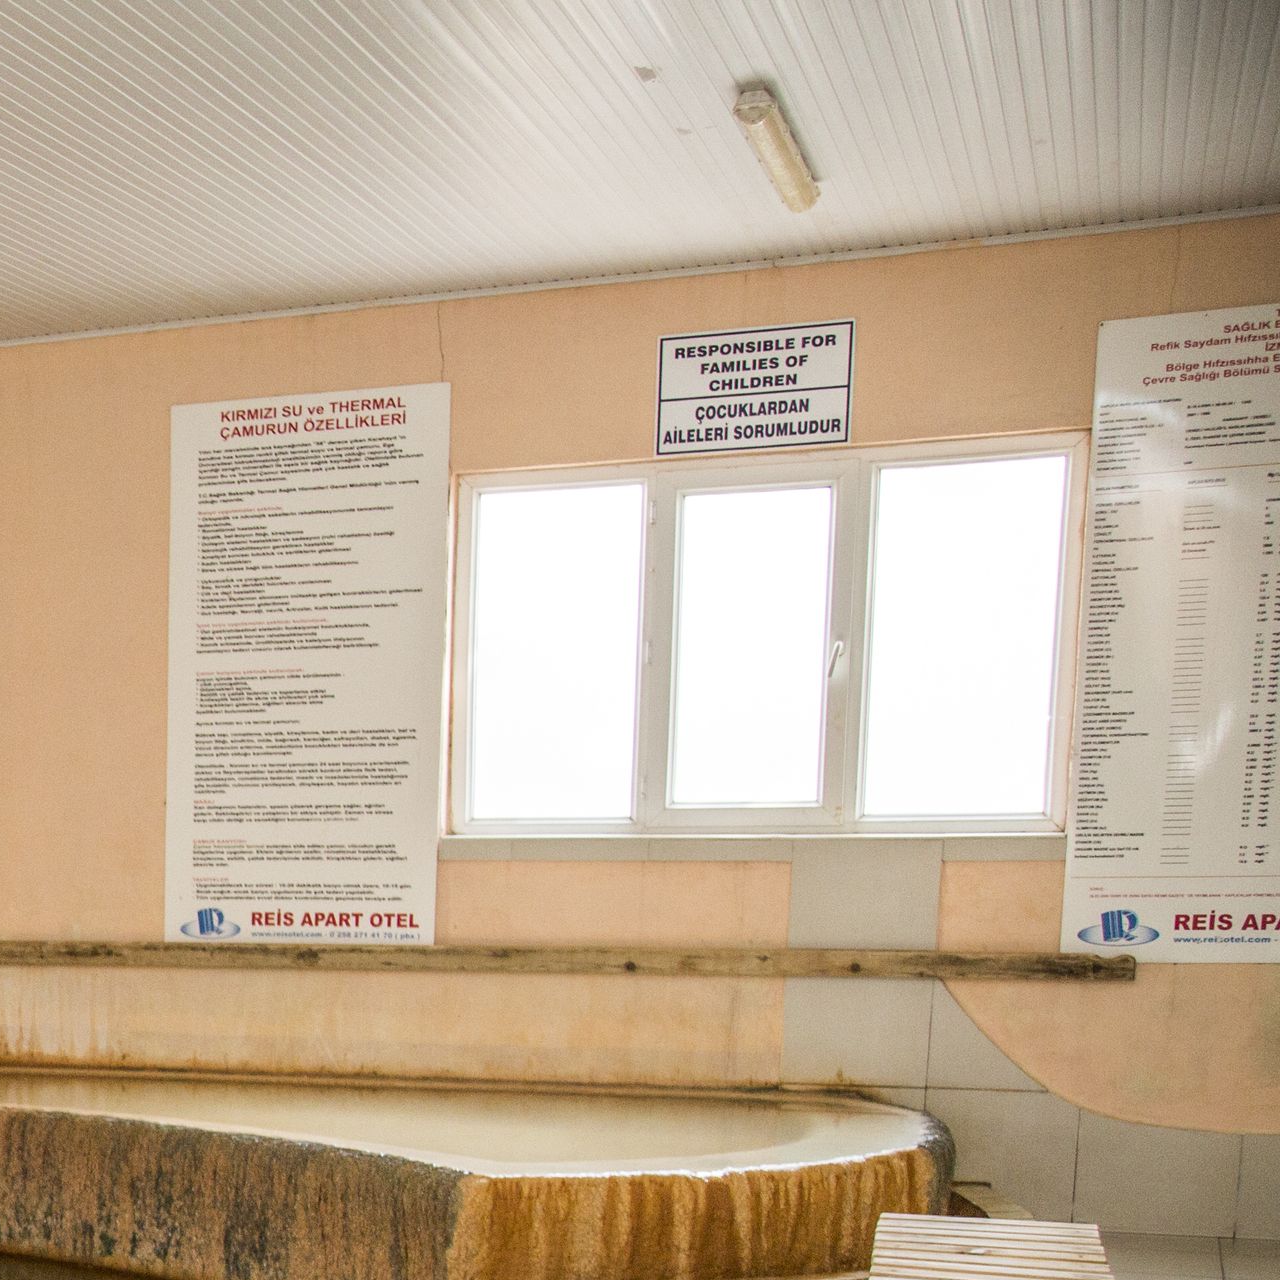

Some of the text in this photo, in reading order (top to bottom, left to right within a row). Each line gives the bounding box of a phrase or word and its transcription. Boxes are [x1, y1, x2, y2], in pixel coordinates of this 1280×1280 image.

[1223, 320, 1271, 334] SAĞLIK
[675, 334, 836, 359] RESPONSIBLE FOR
[1150, 342, 1180, 351] Refik
[1184, 336, 1231, 350] Saydam
[700, 355, 808, 374] FAMILIES OF
[1166, 362, 1200, 373] Bölge
[709, 374, 798, 392] CHILDREN
[1142, 376, 1176, 386] Çevre
[1180, 372, 1220, 382] Sağlığı
[1224, 366, 1270, 378] Bölümü
[221, 396, 406, 423] KIRMIZI SU ve THERMAL
[695, 398, 810, 424] ÇOCUKLARDAN
[220, 412, 407, 442] ÇAMURUN ÖZELLİKLERİ
[663, 418, 840, 444] AİLELERİ SORUMLUDUR
[251, 909, 420, 928] REİS APART OTEL
[1174, 910, 1232, 930] REİS
